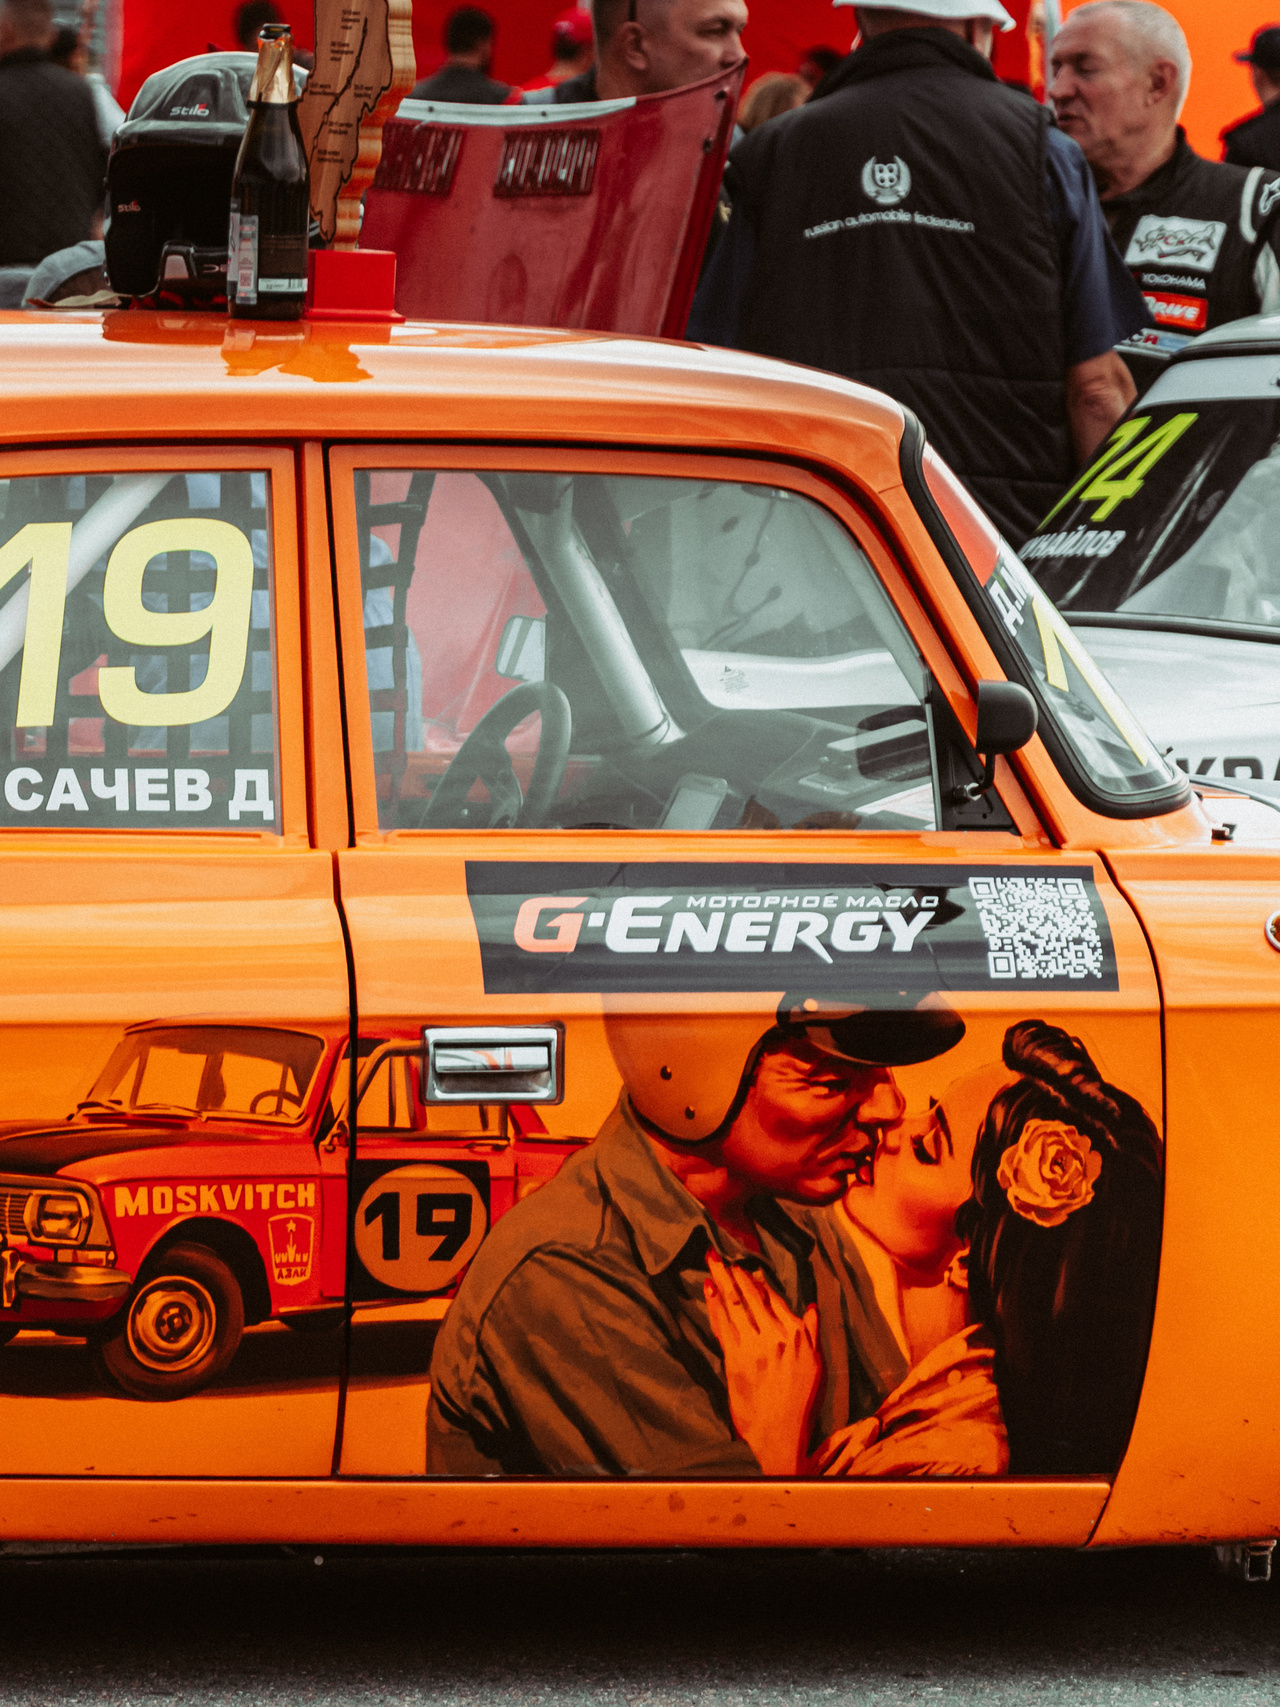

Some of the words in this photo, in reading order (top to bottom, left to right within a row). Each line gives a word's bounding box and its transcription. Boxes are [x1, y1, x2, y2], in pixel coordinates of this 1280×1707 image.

[170, 103, 210, 117] stilo
[803, 220, 845, 239] russian
[845, 208, 913, 227] automobile
[913, 211, 976, 234] federation
[1142, 272, 1207, 291] YOKOHAMA
[1037, 412, 1200, 532] 14
[228, 768, 275, 821] Д
[686, 895, 839, 908] МОТОРНОЕ
[845, 895, 940, 908] МАСЛО
[114, 1182, 317, 1218] MOSKVITCH
[364, 1191, 473, 1262] 19
